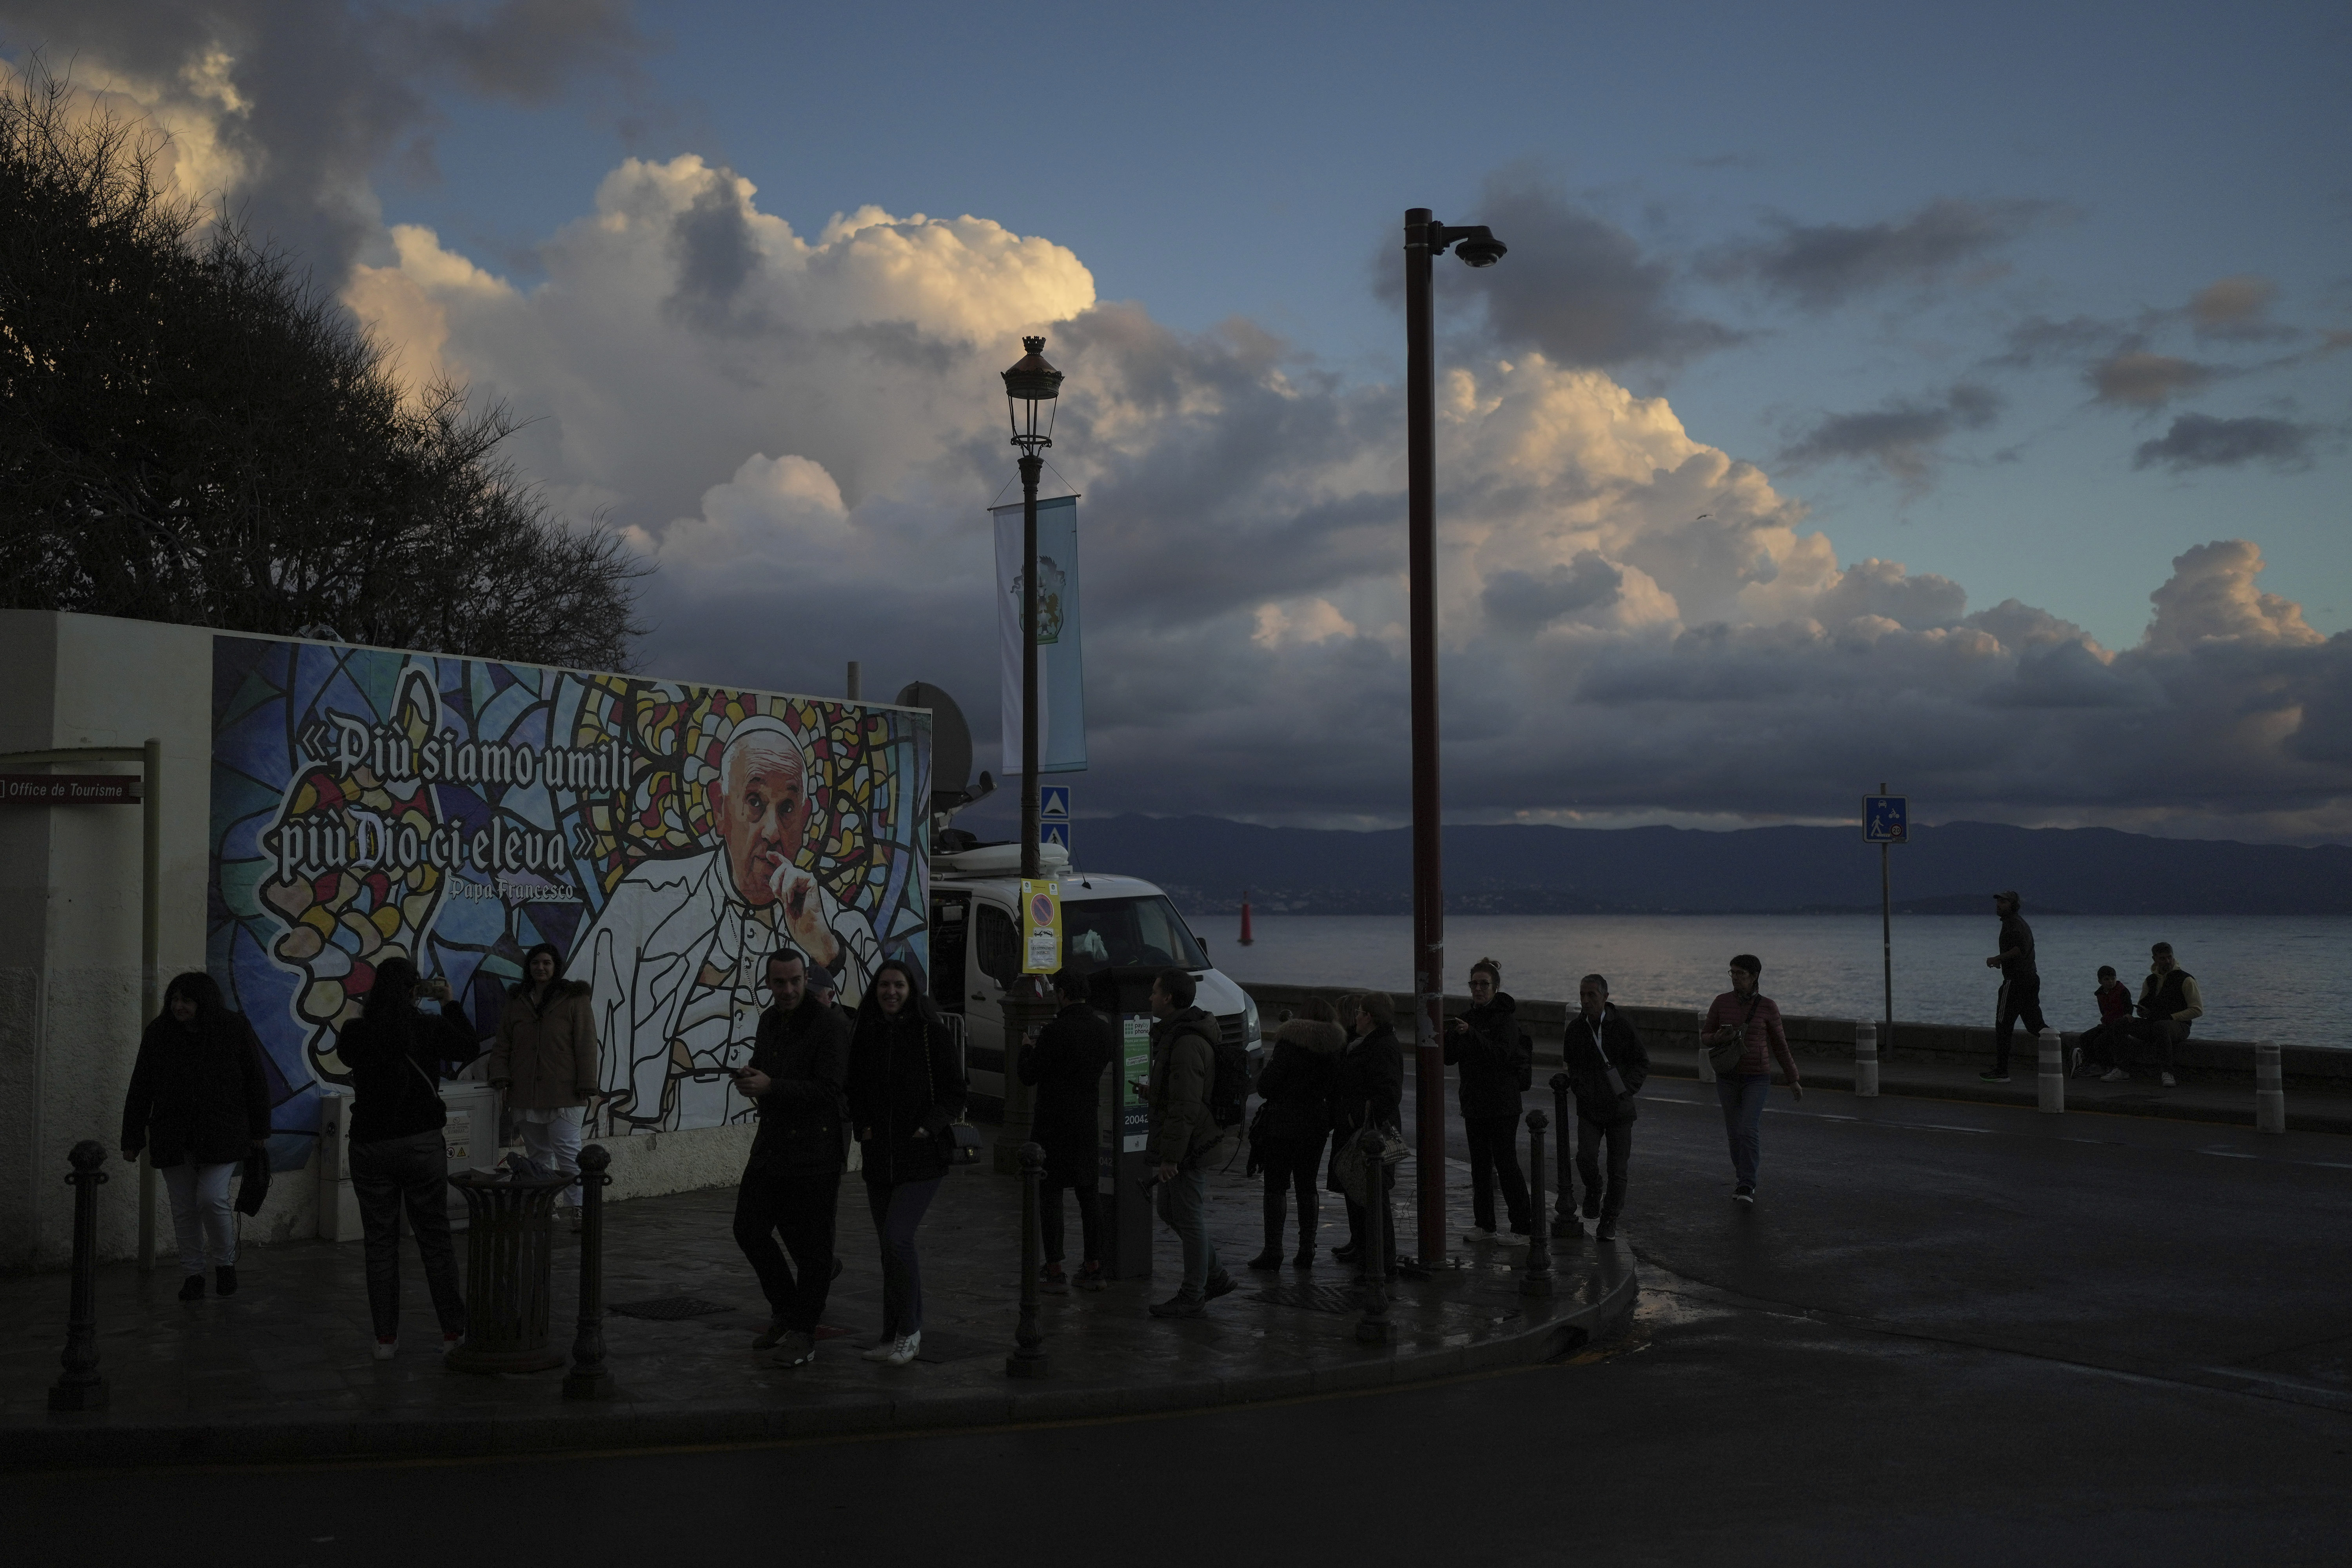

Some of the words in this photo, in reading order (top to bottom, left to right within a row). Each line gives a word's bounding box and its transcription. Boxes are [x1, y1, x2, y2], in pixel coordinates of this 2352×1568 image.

[422, 731, 532, 785] siamo
[544, 740, 632, 791] umili
[10, 782, 47, 796] Office
[51, 783, 65, 796] de
[71, 783, 123, 797] Tourisme
[280, 808, 348, 883] più
[347, 806, 417, 869] Dio
[430, 819, 462, 869] ci
[448, 875, 493, 903] Papa
[495, 877, 573, 900] Francesco
[1125, 1114, 1149, 1125] 20042
